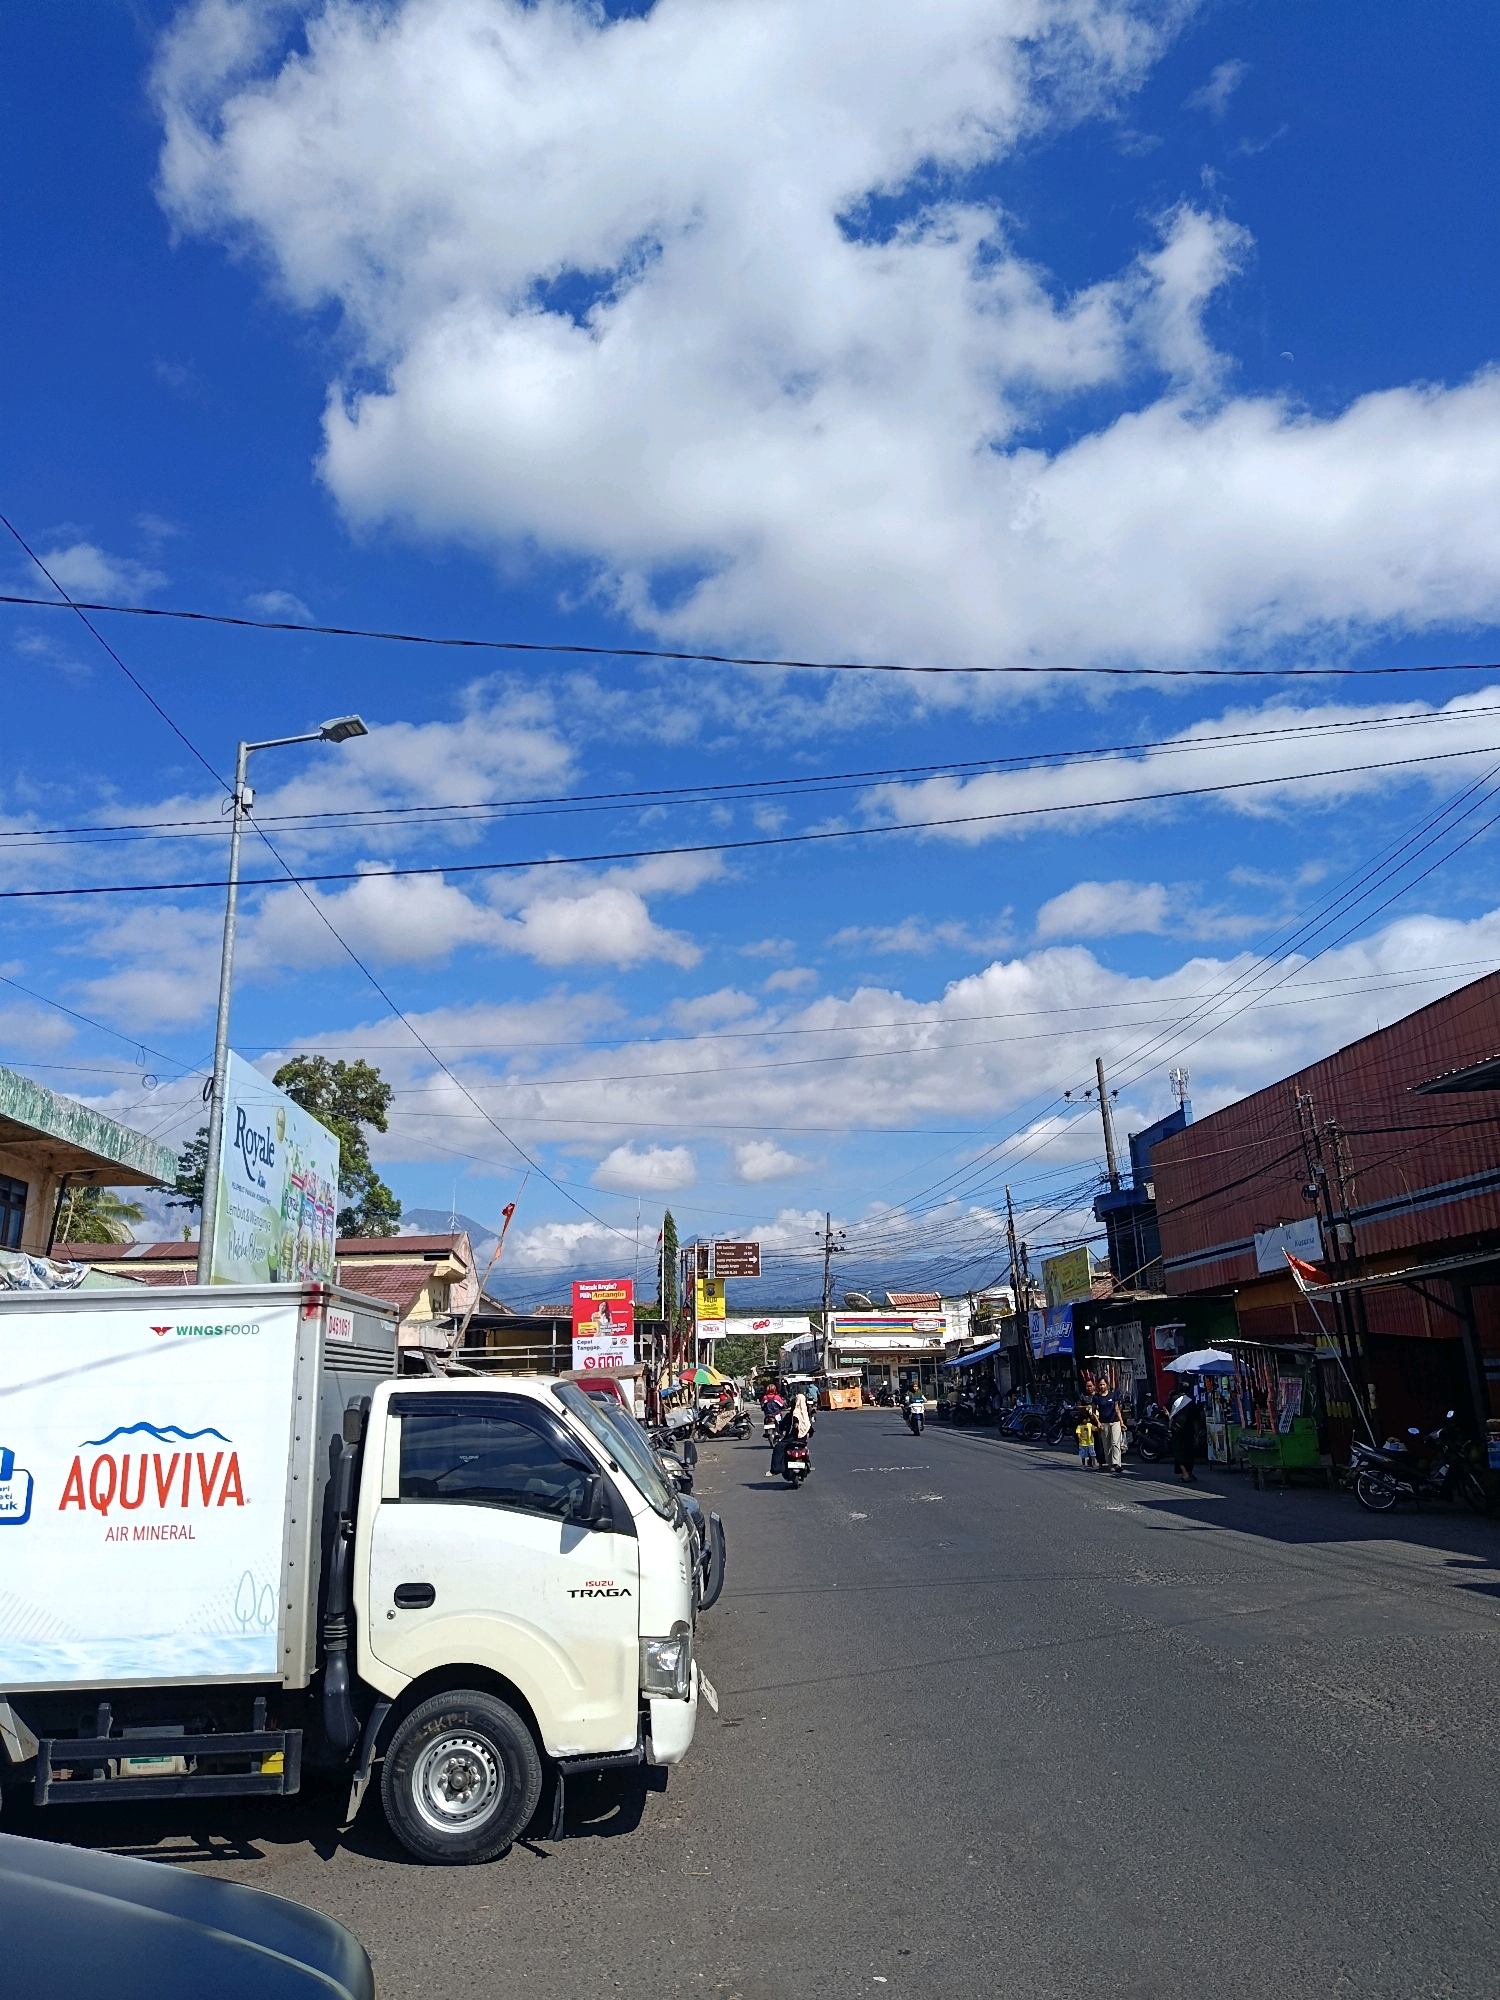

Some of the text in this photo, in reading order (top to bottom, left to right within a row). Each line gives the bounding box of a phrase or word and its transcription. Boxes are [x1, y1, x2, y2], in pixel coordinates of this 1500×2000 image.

[234, 1106, 275, 1181] Royale
[226, 1199, 246, 1221] Lembut
[579, 1282, 618, 1291] Masuk Angin?
[593, 1291, 625, 1299] Antangin
[58, 1451, 245, 1516] AQUVIVA
[105, 1525, 195, 1541] AIR MINERAL
[567, 1588, 632, 1598] TRAGA
